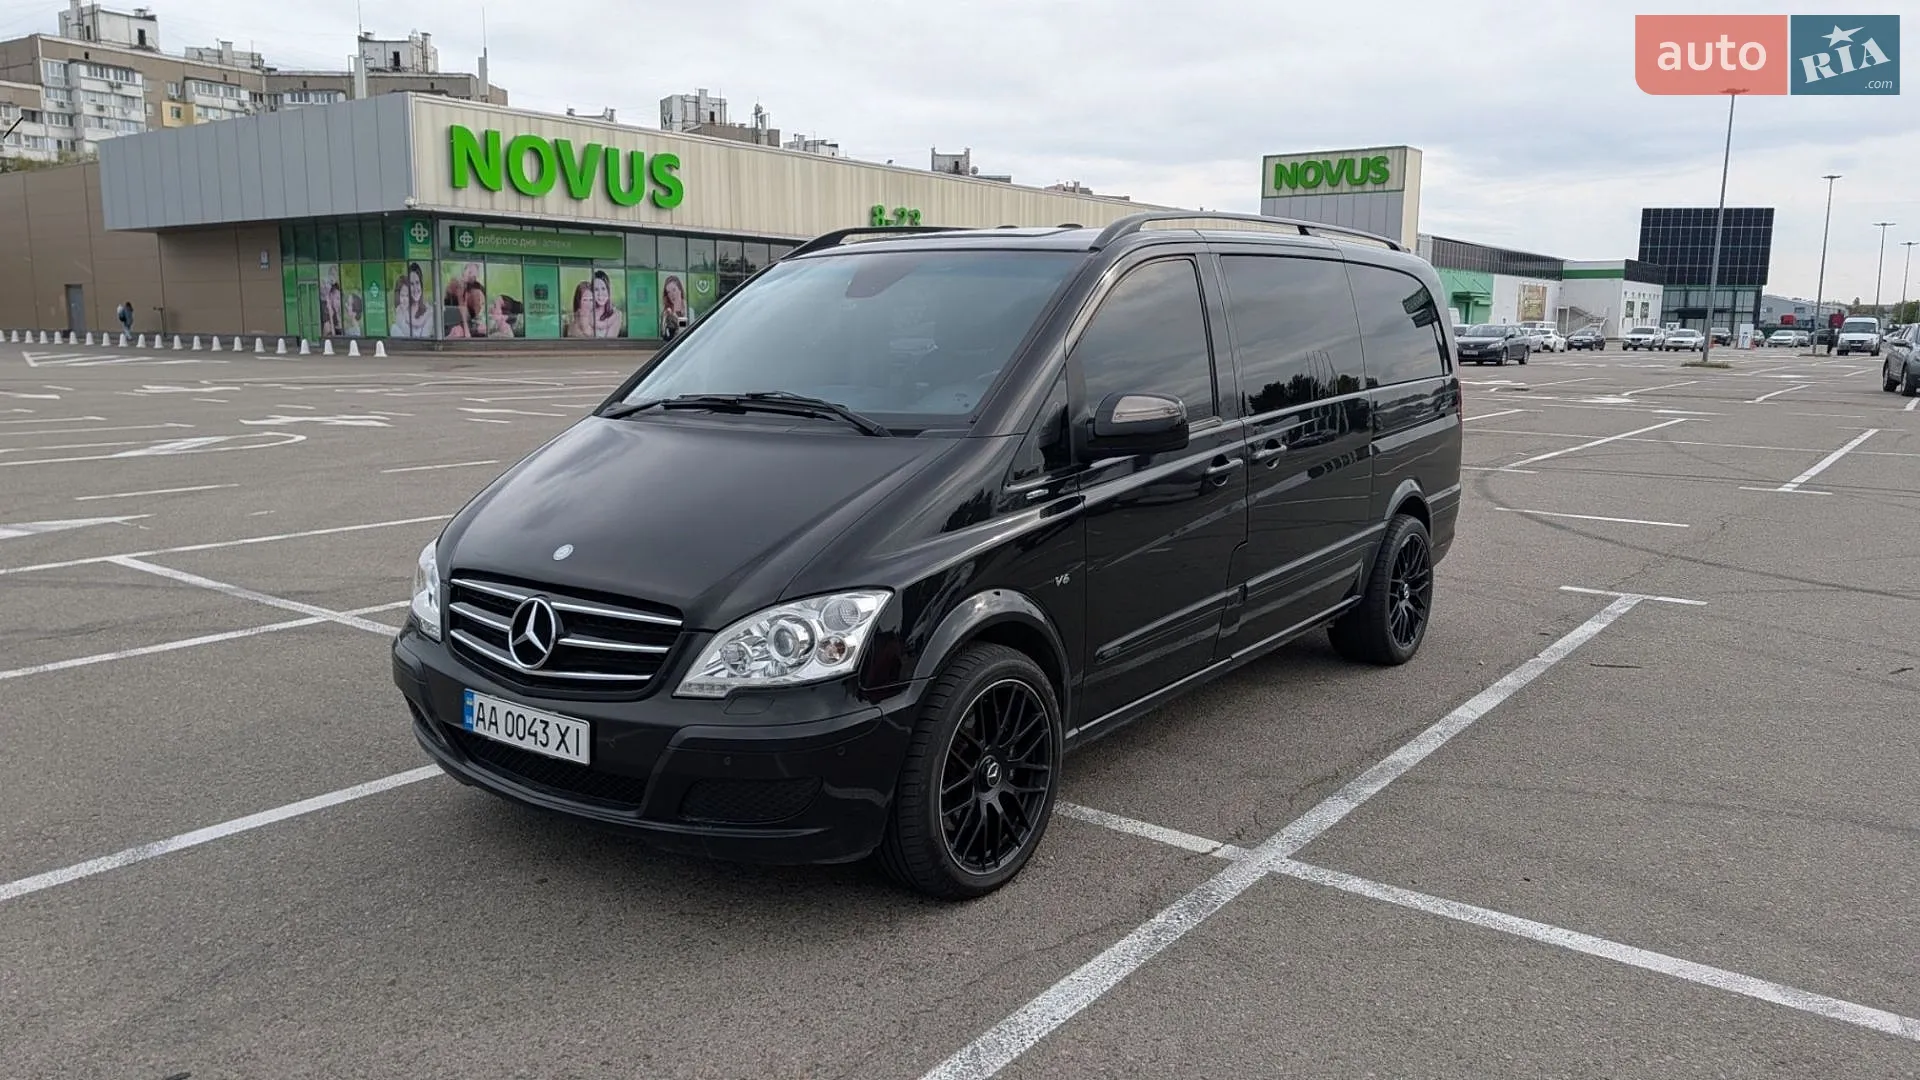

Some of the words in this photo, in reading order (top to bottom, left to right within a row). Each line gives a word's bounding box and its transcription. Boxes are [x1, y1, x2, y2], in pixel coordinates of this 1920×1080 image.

[450, 124, 684, 209] NOVUS
[1273, 156, 1390, 190] NOVUS
[1055, 573, 1070, 587] V6
[475, 702, 499, 734] AA
[504, 710, 550, 748] 0043
[555, 723, 580, 757] XI
